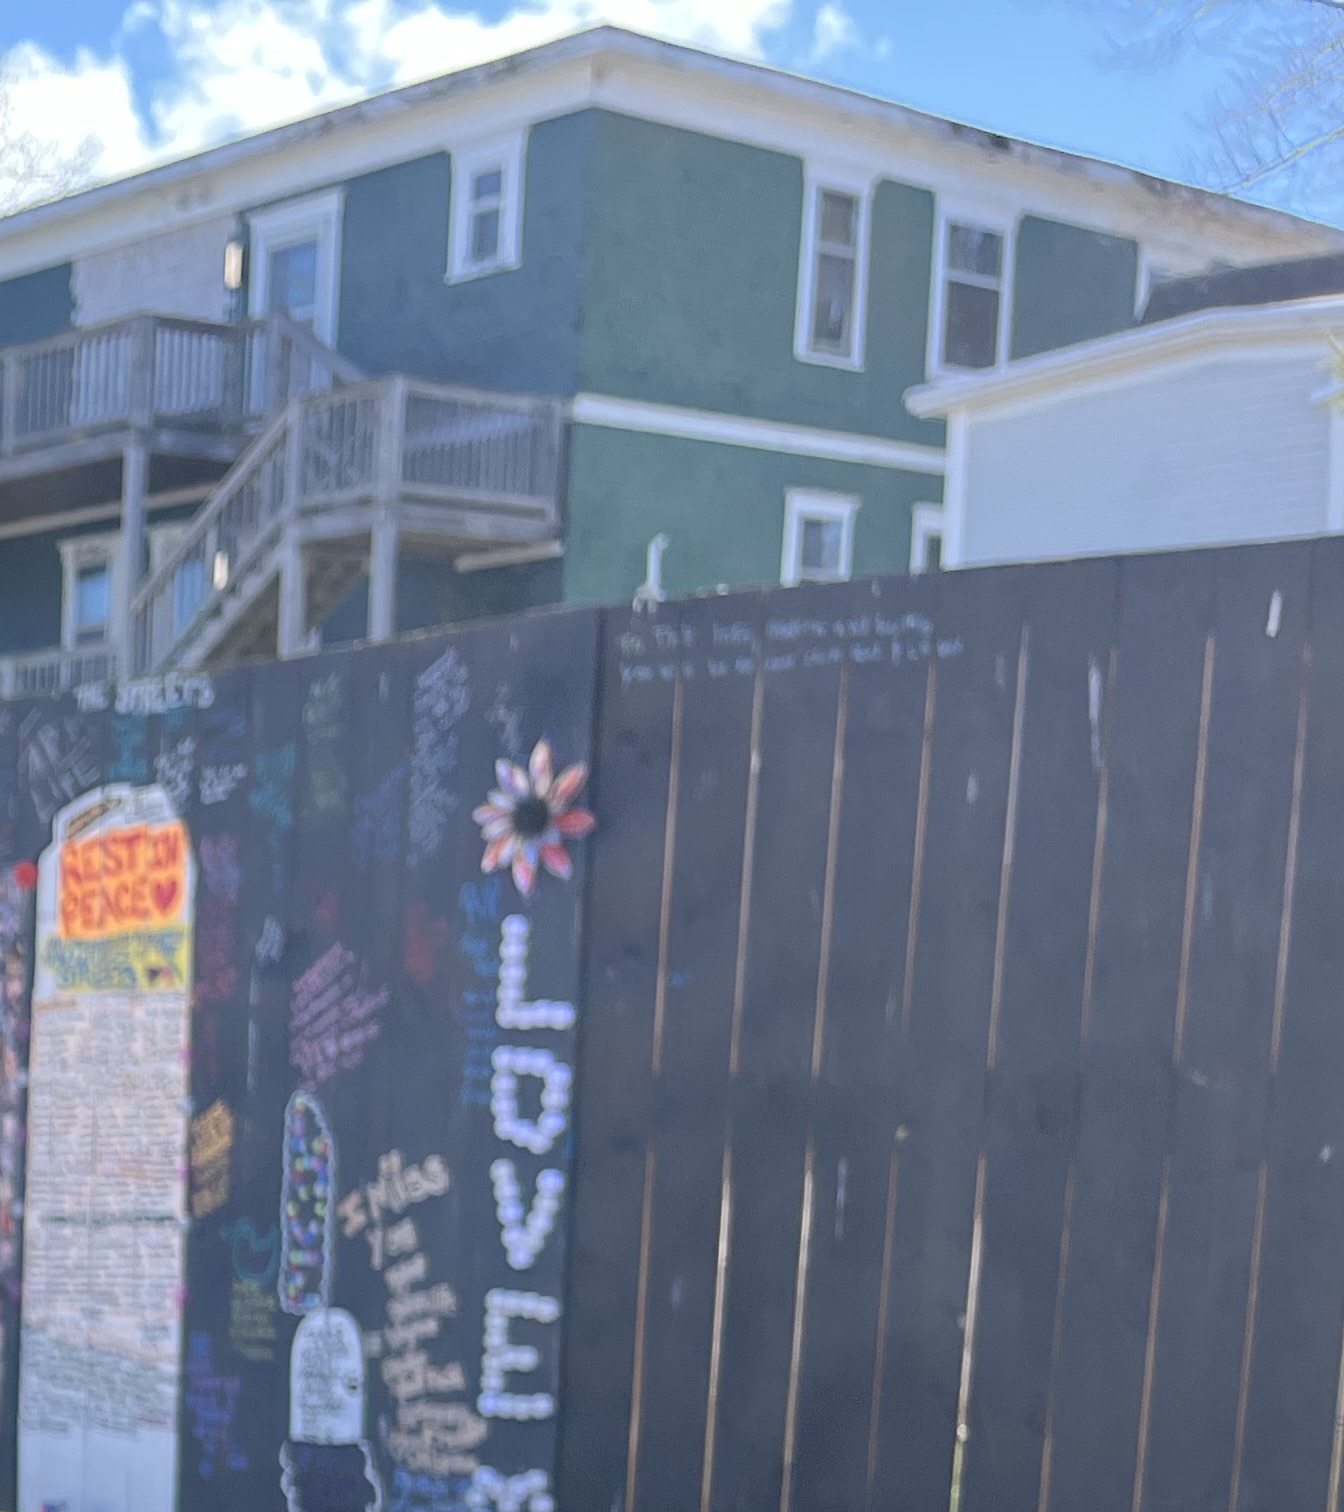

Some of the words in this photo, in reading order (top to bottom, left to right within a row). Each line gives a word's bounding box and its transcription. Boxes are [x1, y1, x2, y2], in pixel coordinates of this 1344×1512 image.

[61, 828, 148, 888] REST
[149, 830, 180, 871] IN
[61, 874, 153, 938] PEACE
[477, 913, 577, 1421] LOVE
